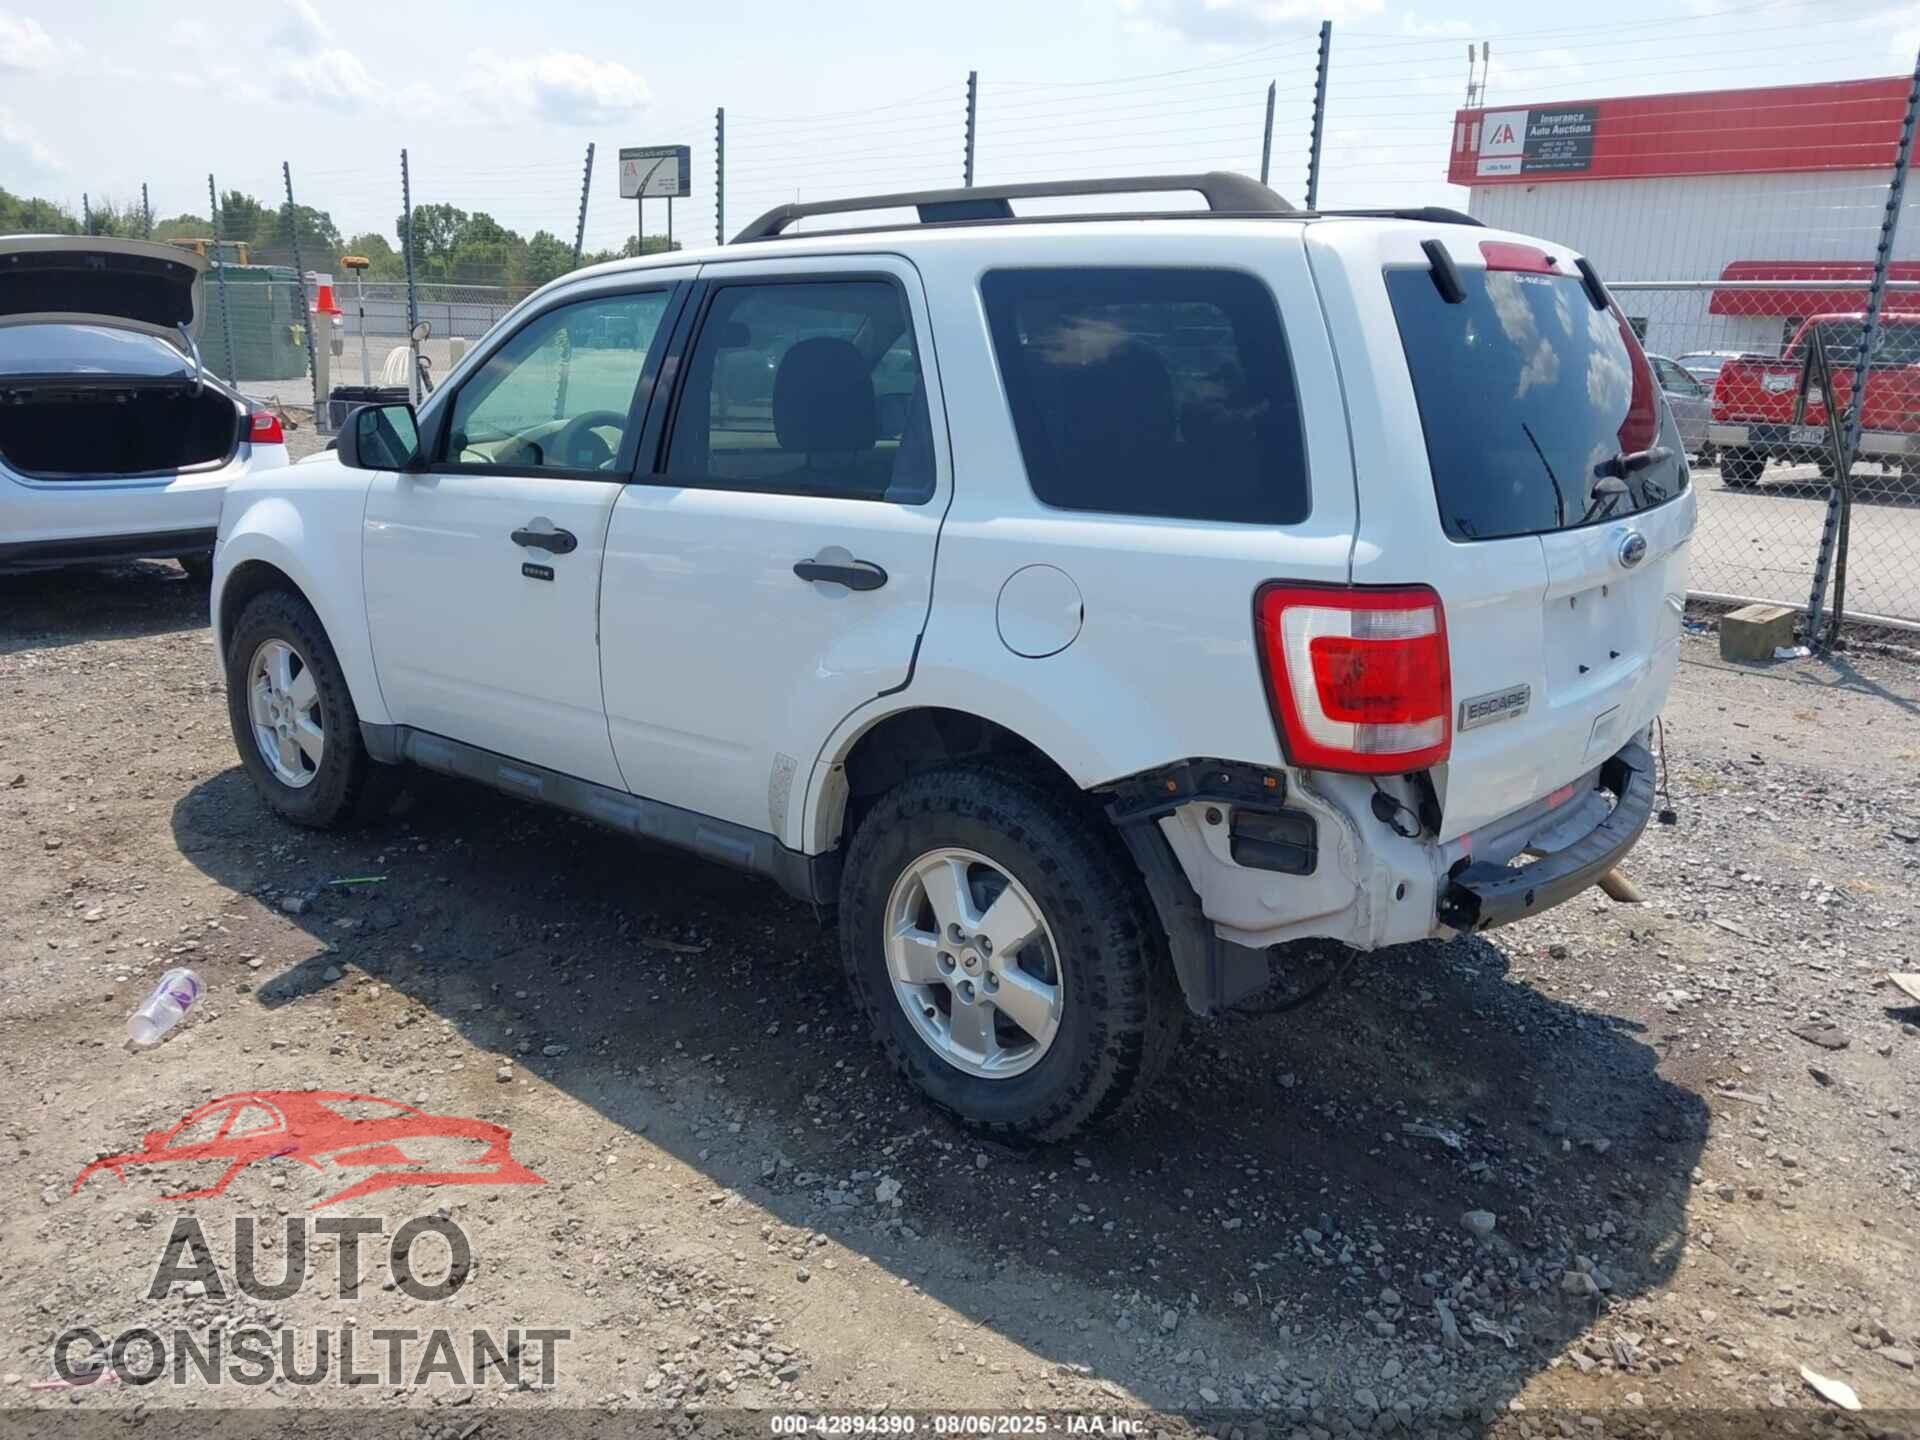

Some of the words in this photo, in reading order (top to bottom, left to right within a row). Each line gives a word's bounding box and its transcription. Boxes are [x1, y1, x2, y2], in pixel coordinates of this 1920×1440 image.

[1541, 113, 1584, 124] Insurance
[1530, 126, 1550, 137] Auto
[1552, 125, 1592, 135] Auctions
[1469, 692, 1525, 717] ESCAPE
